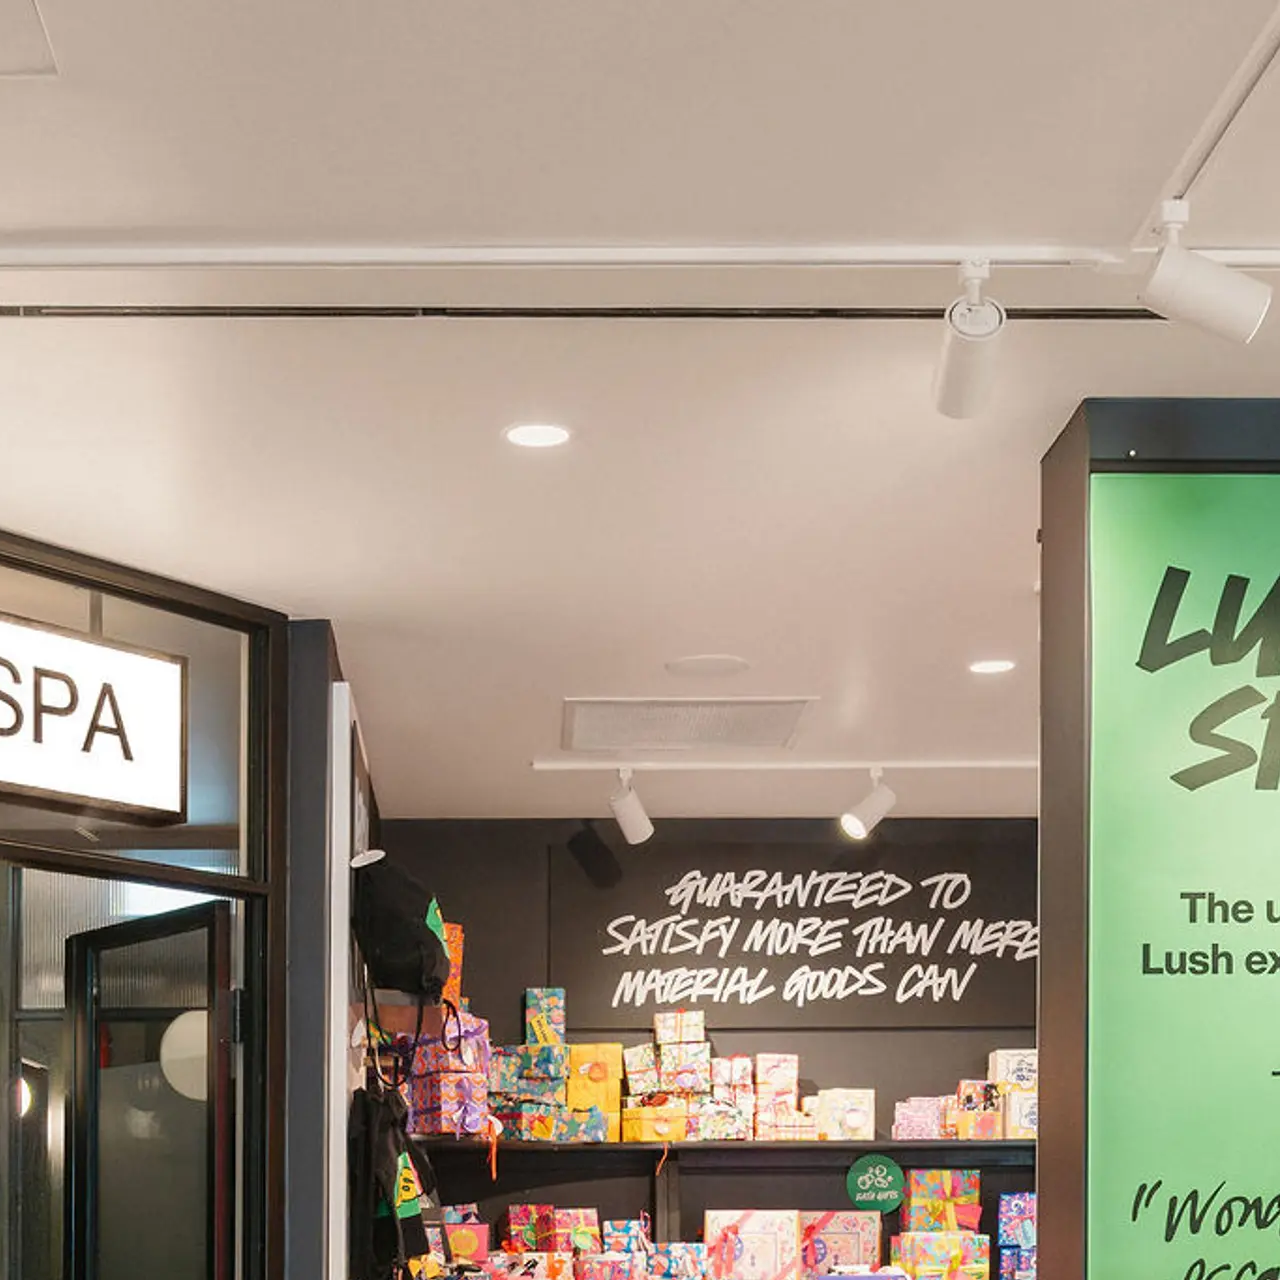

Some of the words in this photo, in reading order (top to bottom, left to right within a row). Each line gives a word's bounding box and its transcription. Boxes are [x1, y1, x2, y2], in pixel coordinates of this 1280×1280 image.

[665, 870, 913, 914] GUARANTEED
[921, 873, 972, 909] TO
[1180, 892, 1254, 923] The
[603, 915, 742, 957] SATISFY
[742, 917, 849, 957] MORE
[852, 917, 945, 957] THAN
[1142, 943, 1233, 974] Lush
[612, 966, 775, 1008] MATERIAL
[783, 963, 886, 1008] GOODS
[896, 963, 977, 1002] CAN
